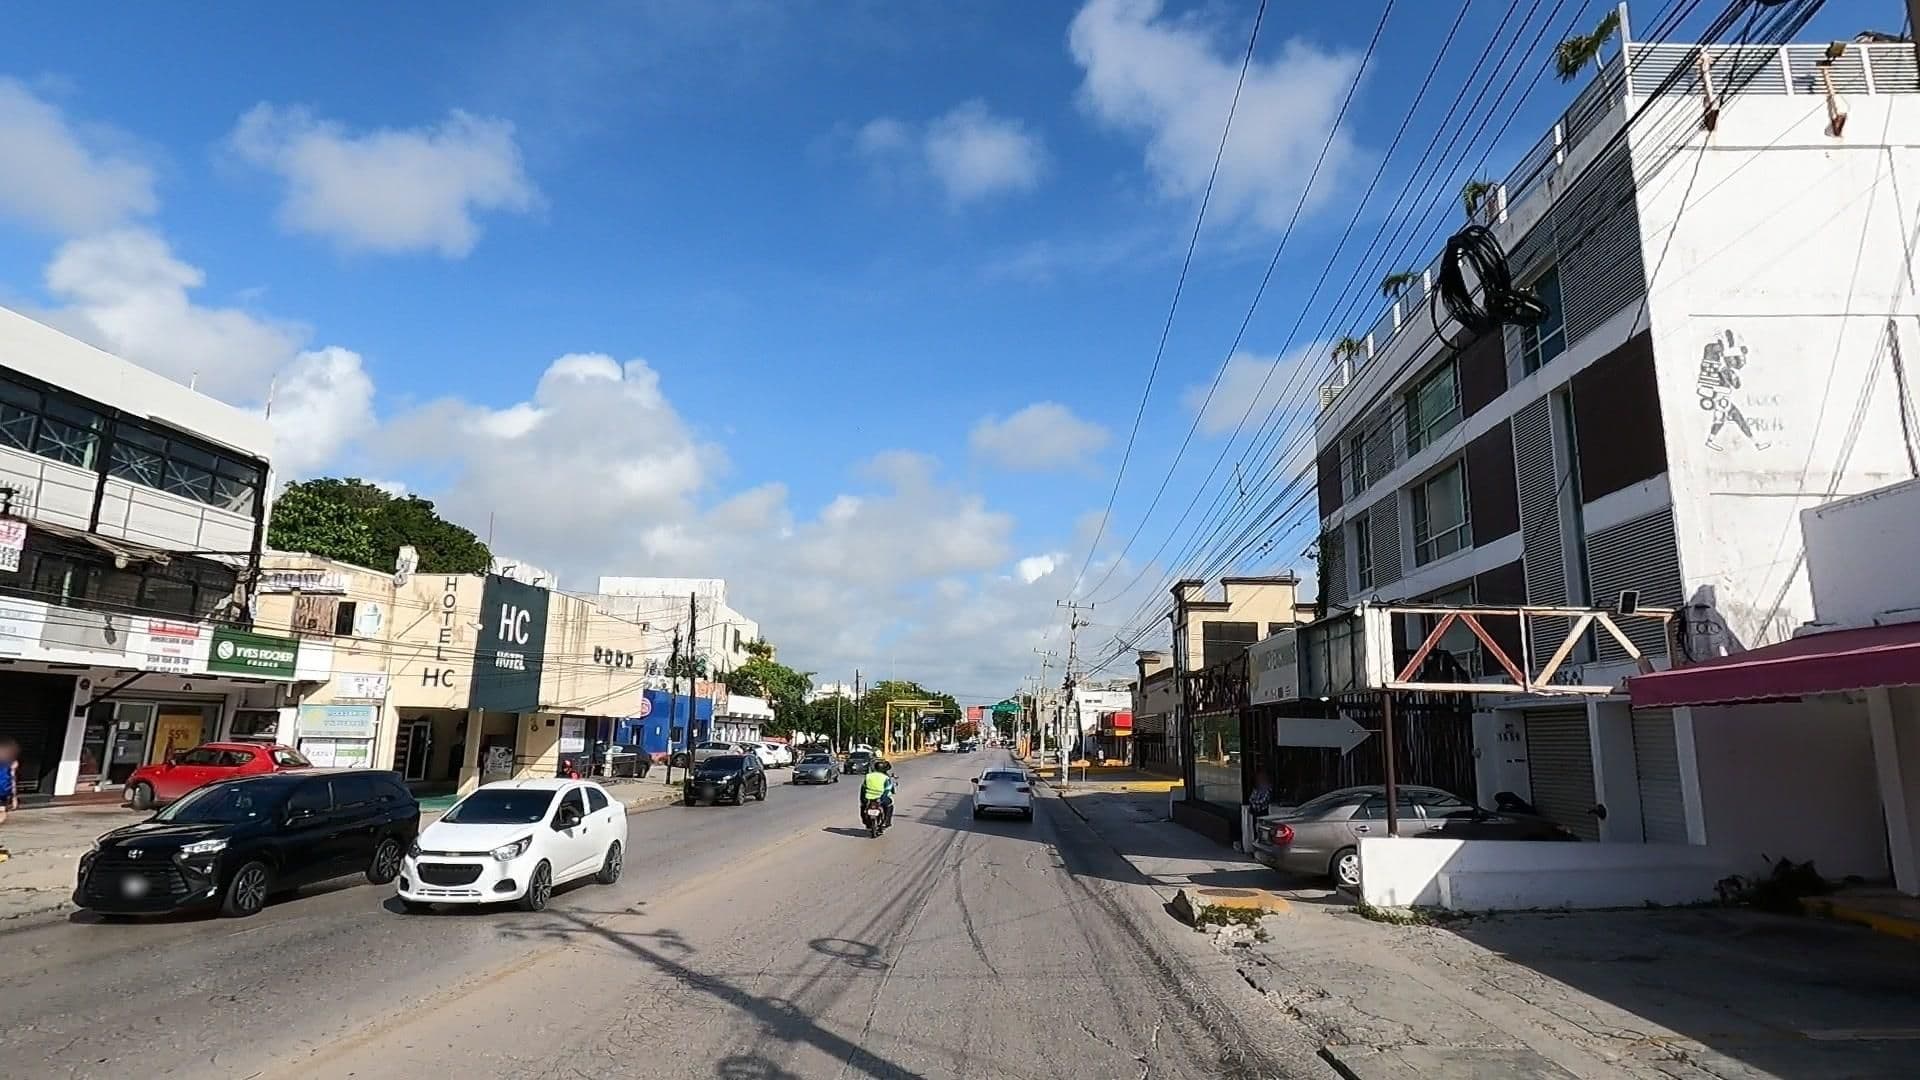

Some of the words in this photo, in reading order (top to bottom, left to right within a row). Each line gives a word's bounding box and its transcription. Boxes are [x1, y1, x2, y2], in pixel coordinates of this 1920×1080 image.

[437, 576, 458, 662] HOTEL
[498, 603, 531, 645] HC
[236, 647, 259, 658] YVES
[259, 649, 294, 662] ROCHER
[495, 650, 526, 671] HOTEL
[422, 667, 455, 688] HC
